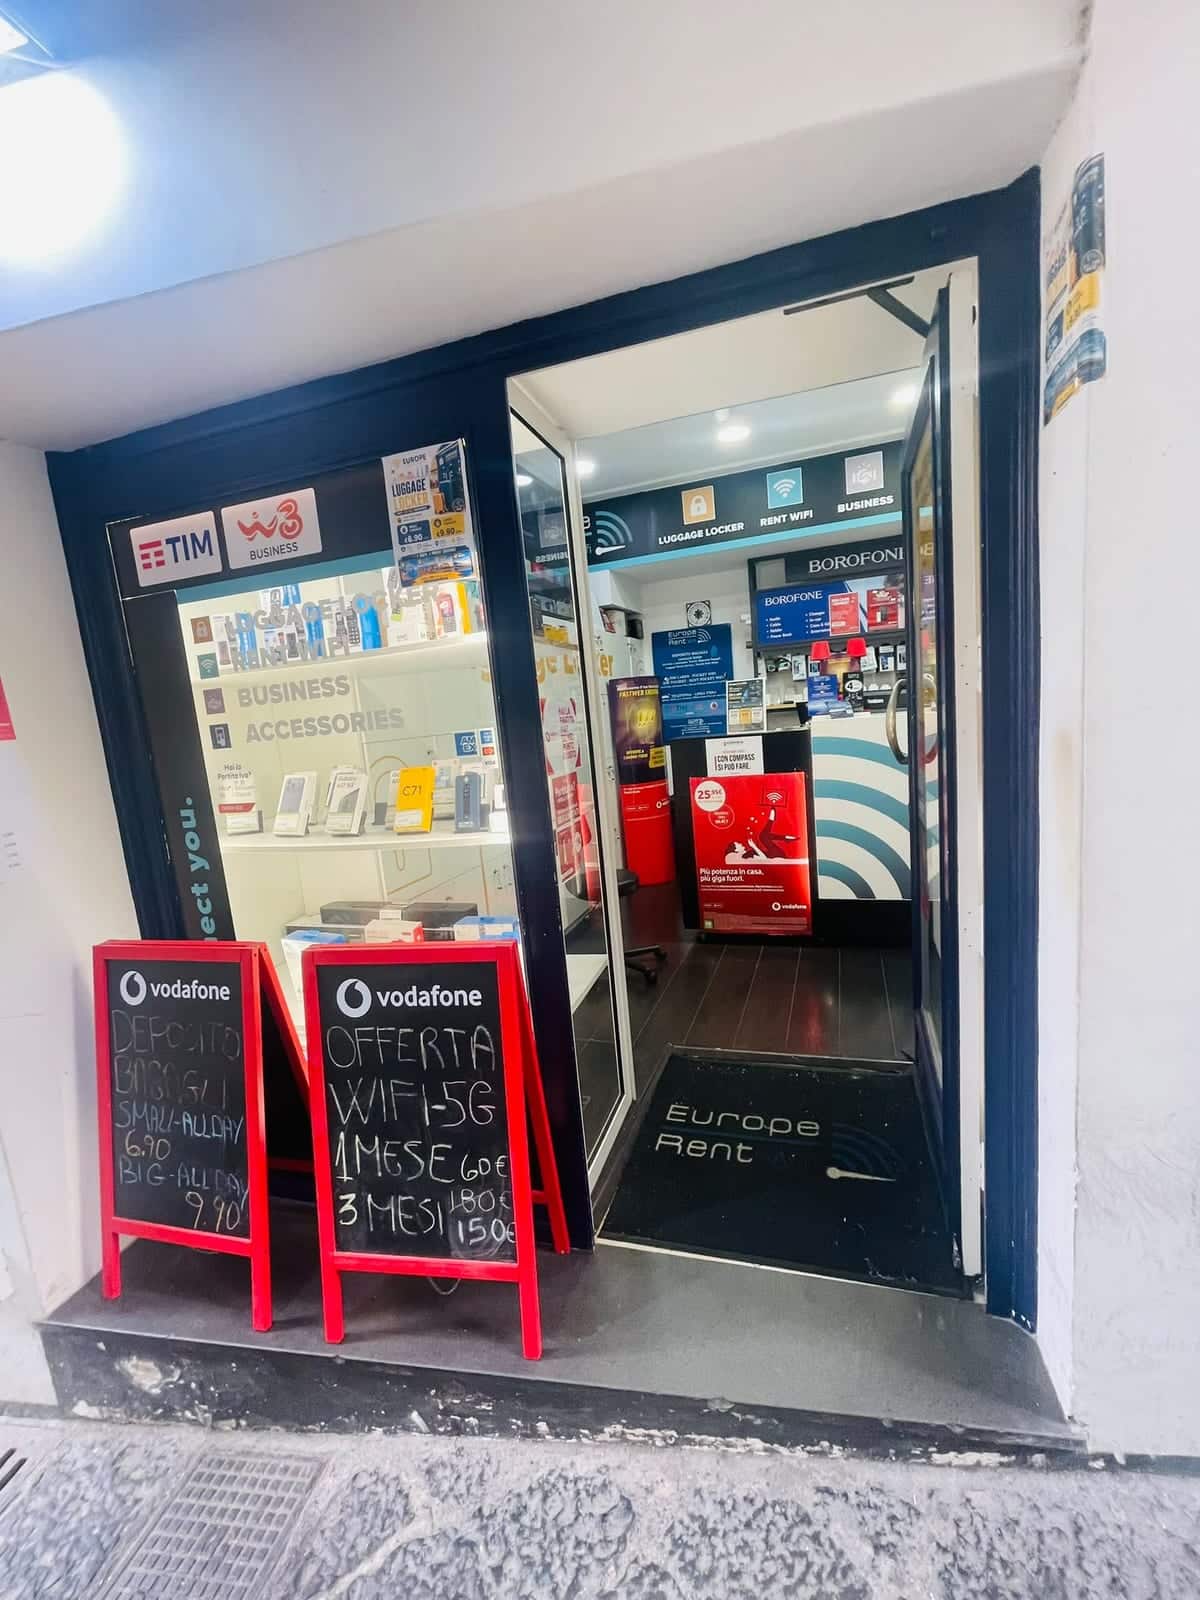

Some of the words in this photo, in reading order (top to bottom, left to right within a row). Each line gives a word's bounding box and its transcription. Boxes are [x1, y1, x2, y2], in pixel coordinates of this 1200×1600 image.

[392, 478, 427, 498] LUGGAGE
[836, 495, 894, 514] BUSINESS
[759, 514, 786, 527] RENT
[788, 509, 813, 523] WIFI
[658, 529, 704, 545] LUGGAGE
[705, 522, 745, 538] LOCKER
[164, 529, 215, 565] TIM
[249, 541, 299, 561] BUSINESS
[764, 590, 823, 607] BOROFONE
[238, 675, 351, 708] BUSINESS
[245, 707, 405, 744] ACCESSORIES
[717, 754, 728, 763] CON
[729, 753, 755, 762] COMPASS
[402, 785, 422, 797] C71
[179, 796, 210, 872] you.
[711, 875, 726, 883] giga
[726, 874, 744, 882] fuori.
[712, 868, 738, 876] potenza
[739, 867, 746, 875] in
[747, 868, 764, 876] casa,
[150, 979, 231, 1001] vodafone
[376, 985, 483, 1008] vodafone
[326, 1025, 496, 1072] OFFERTA
[665, 1104, 820, 1137] Europe
[125, 1128, 171, 1161] 6.90
[655, 1133, 753, 1163] Rent
[185, 1191, 240, 1232] 9.90
[338, 1192, 358, 1225] 3
[367, 1193, 444, 1236] MESI
